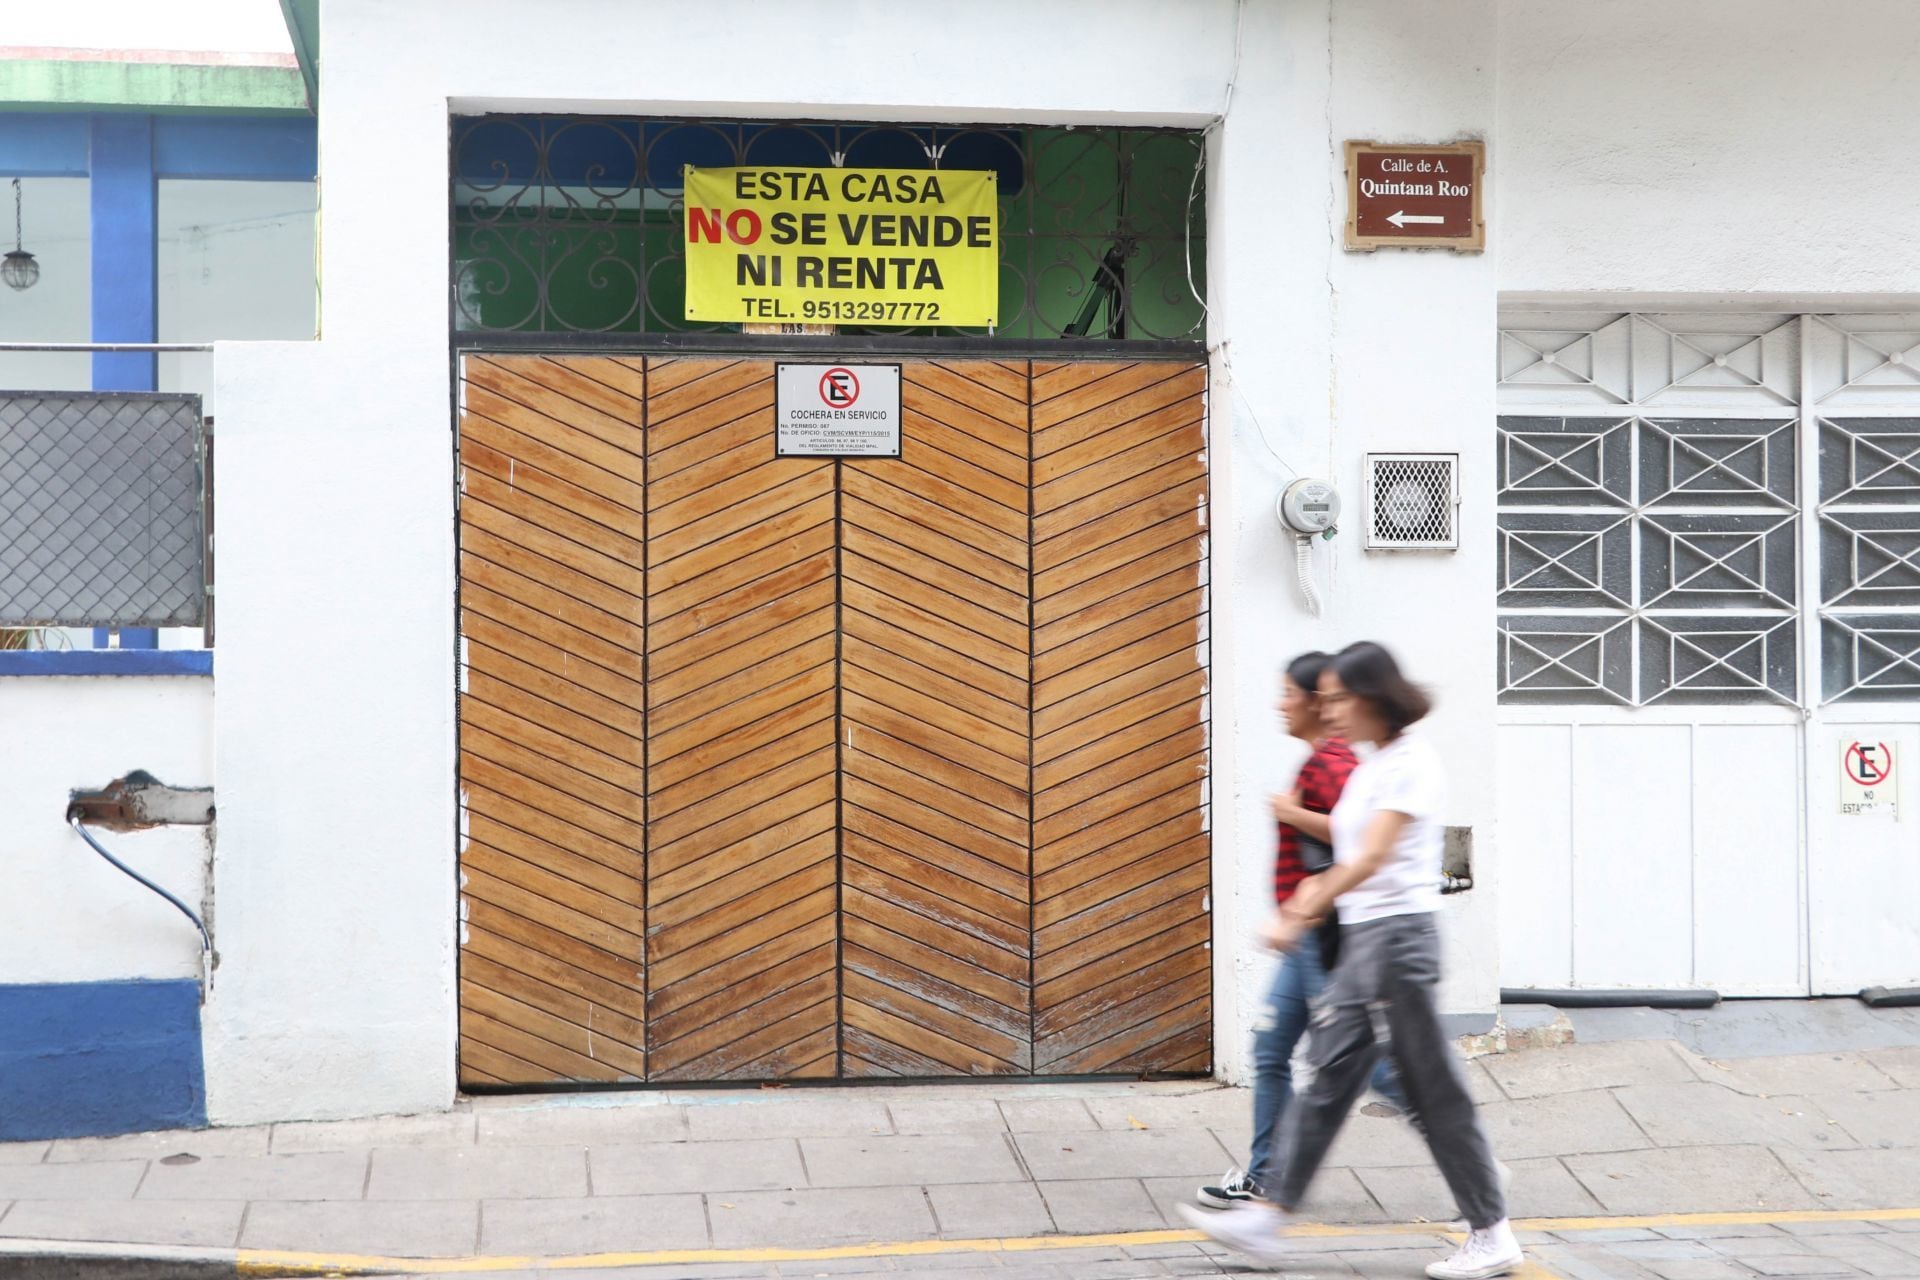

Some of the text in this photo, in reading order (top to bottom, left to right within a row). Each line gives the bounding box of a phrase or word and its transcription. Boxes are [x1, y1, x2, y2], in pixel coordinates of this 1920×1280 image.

[1381, 158, 1449, 173] Calle de A.
[736, 171, 945, 204] ESTA CASA
[1360, 179, 1469, 198] Quintana Roo
[688, 207, 992, 248] NO SE VENDE
[737, 254, 945, 290] NI RENTA
[742, 298, 941, 321] TEL. 9513297772
[791, 410, 887, 420] COCHERA EN SERVICIO
[1864, 790, 1874, 800] NO
